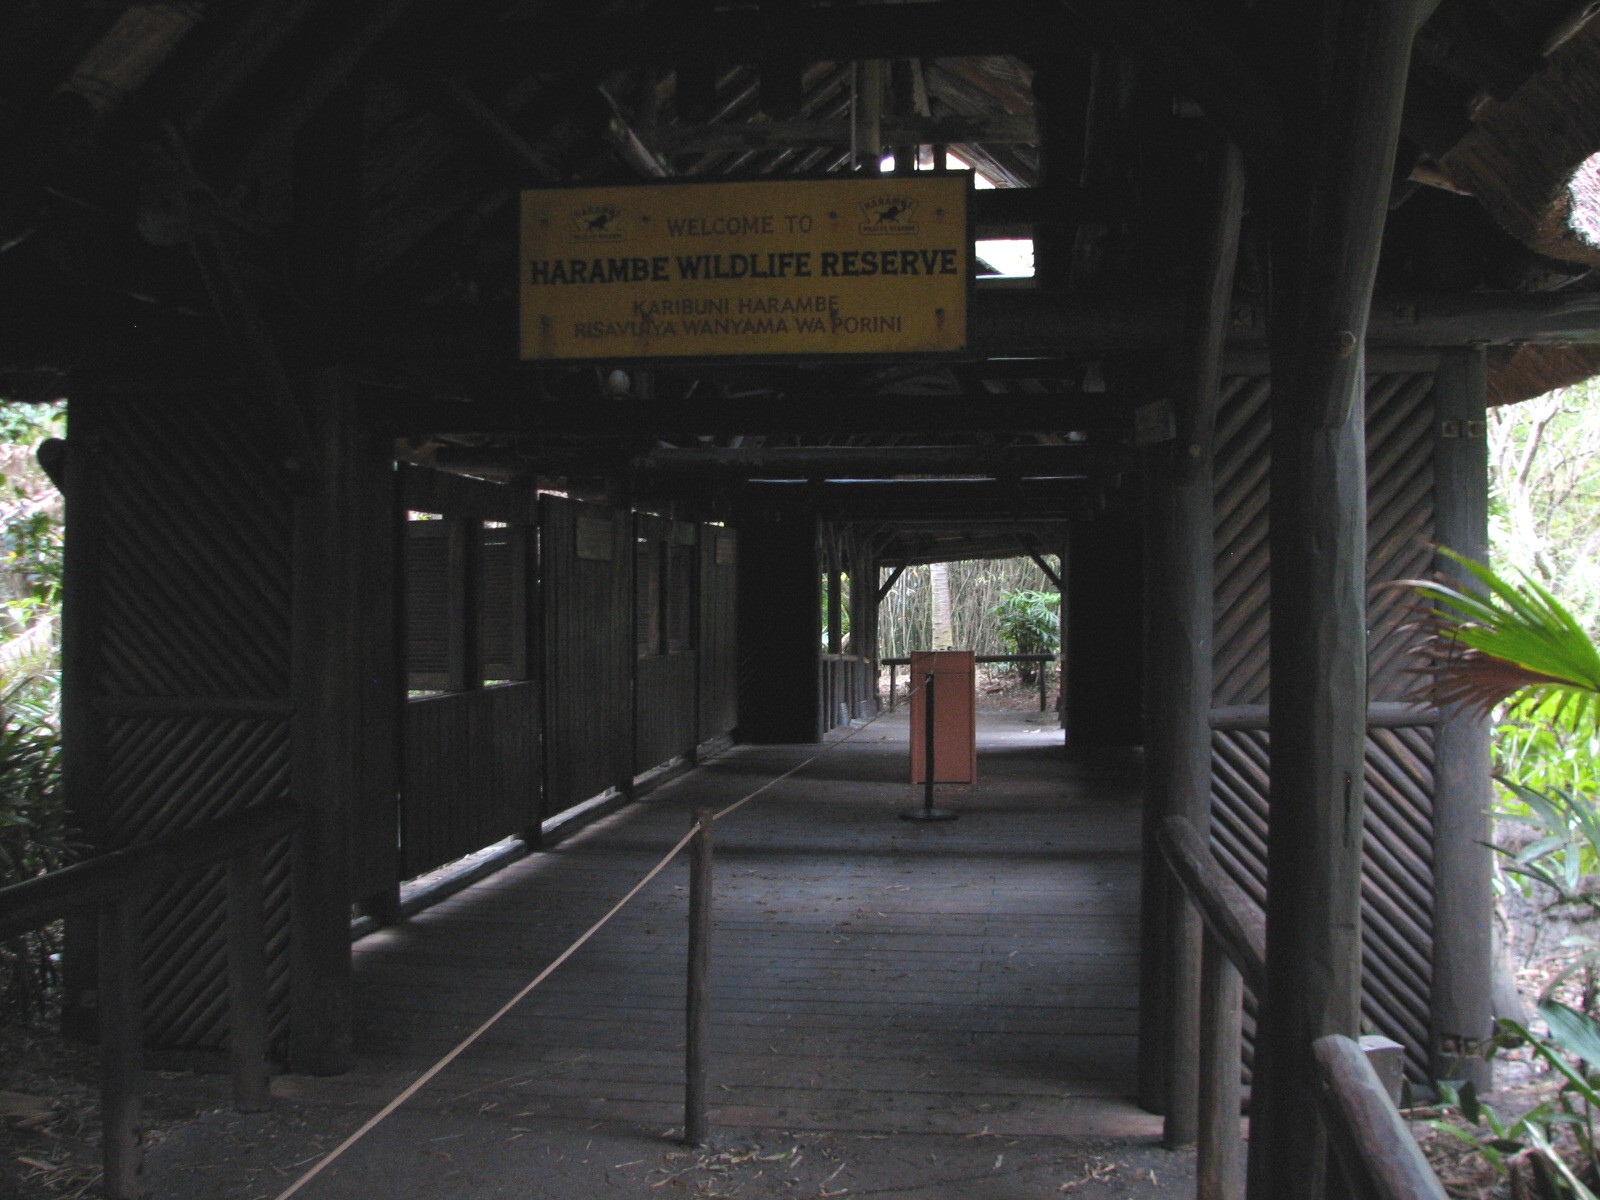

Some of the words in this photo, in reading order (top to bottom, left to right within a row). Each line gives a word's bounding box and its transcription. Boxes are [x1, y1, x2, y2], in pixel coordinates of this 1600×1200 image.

[667, 215, 774, 237] WELCOME
[785, 214, 813, 234] TO
[530, 256, 670, 285] HARAMBE
[676, 252, 812, 280] WILDLIFE
[821, 248, 958, 278] RESERVE
[633, 298, 730, 317] KARIBUNI
[738, 295, 840, 315] HARAMBE
[682, 317, 789, 336] WANYAMA
[794, 317, 826, 334] WA
[831, 315, 902, 334] PORINI
